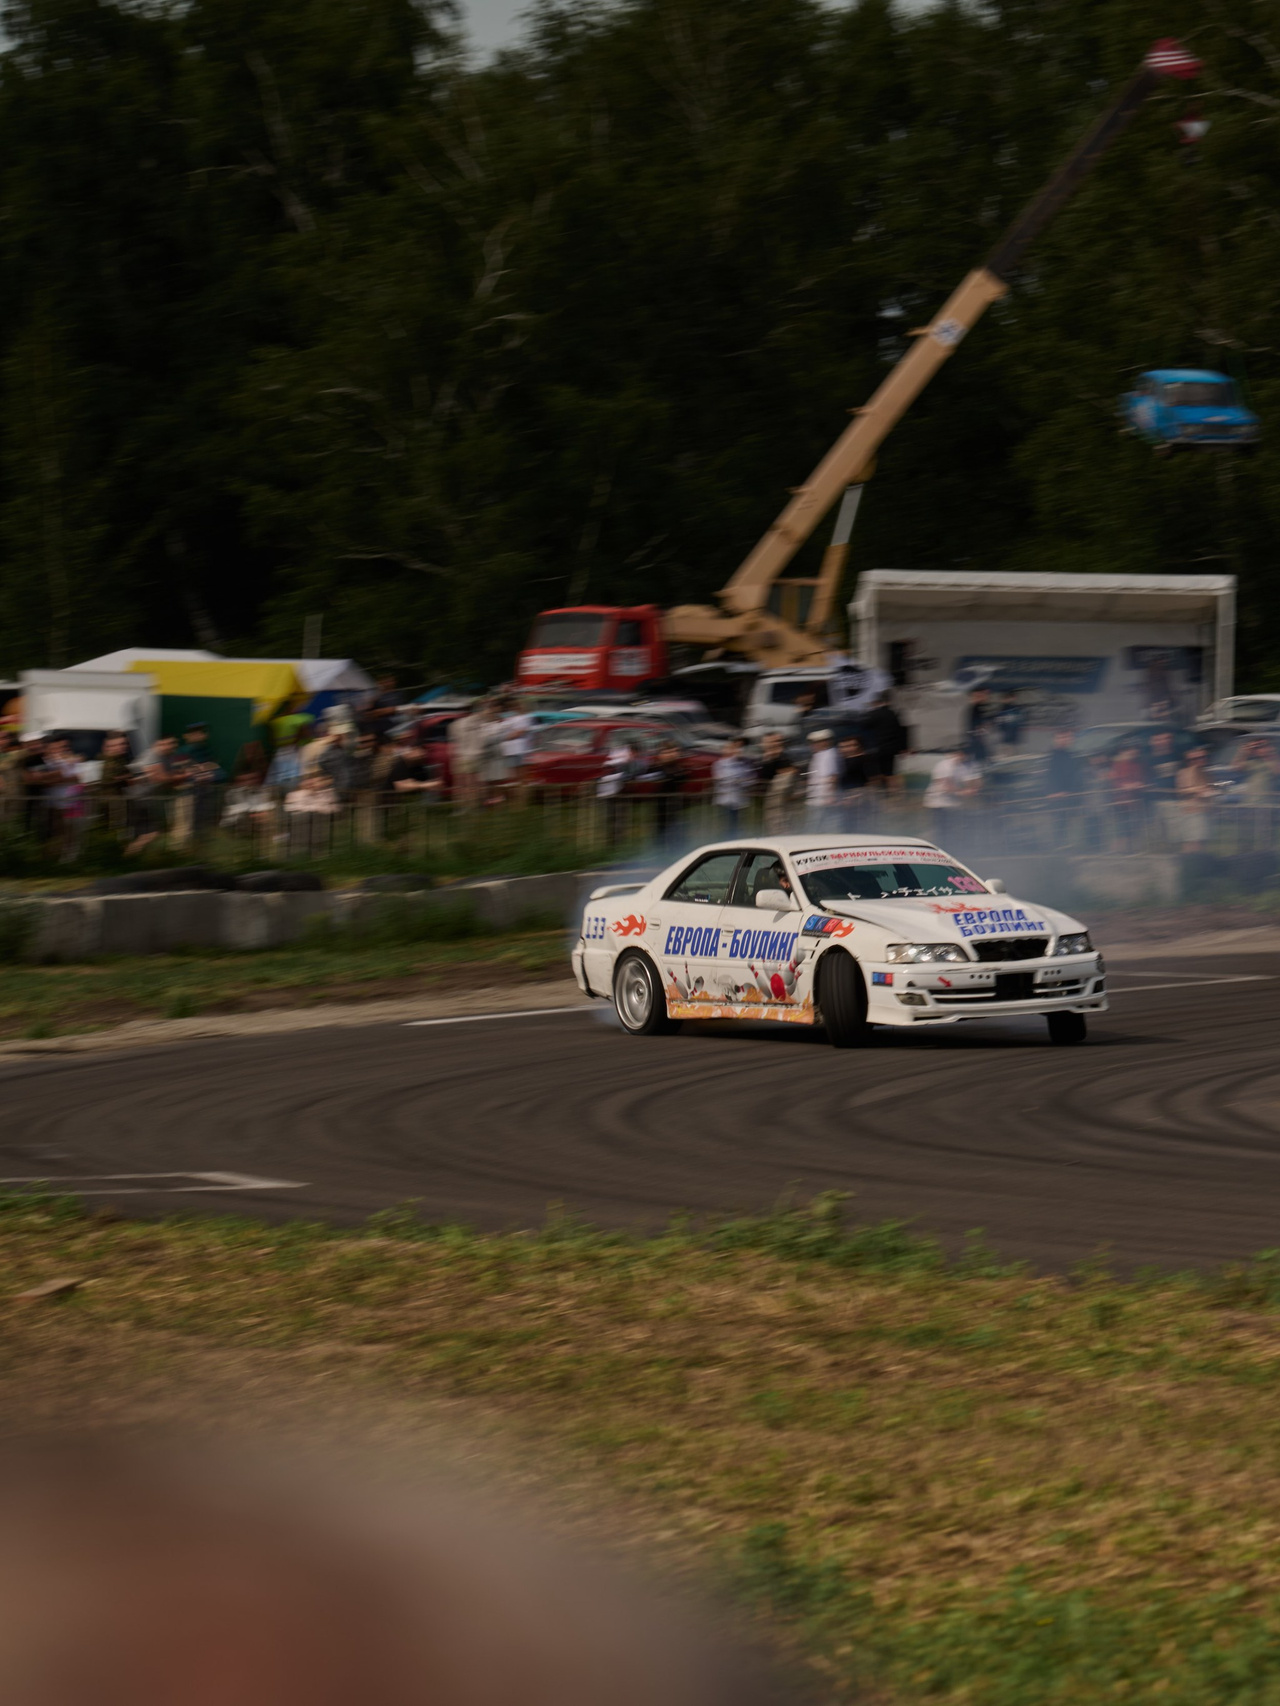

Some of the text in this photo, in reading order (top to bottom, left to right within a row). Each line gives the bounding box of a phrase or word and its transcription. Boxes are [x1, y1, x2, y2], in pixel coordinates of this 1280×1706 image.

[795, 854, 828, 866] КУБОК
[805, 915, 840, 932] SKR
[953, 909, 1028, 926] ЕВРОПА
[585, 916, 606, 939] 133
[959, 921, 1046, 938] БОУЛИНГ
[664, 926, 722, 957] ЕВРОПА
[729, 928, 799, 962] БОУЛИНГ
